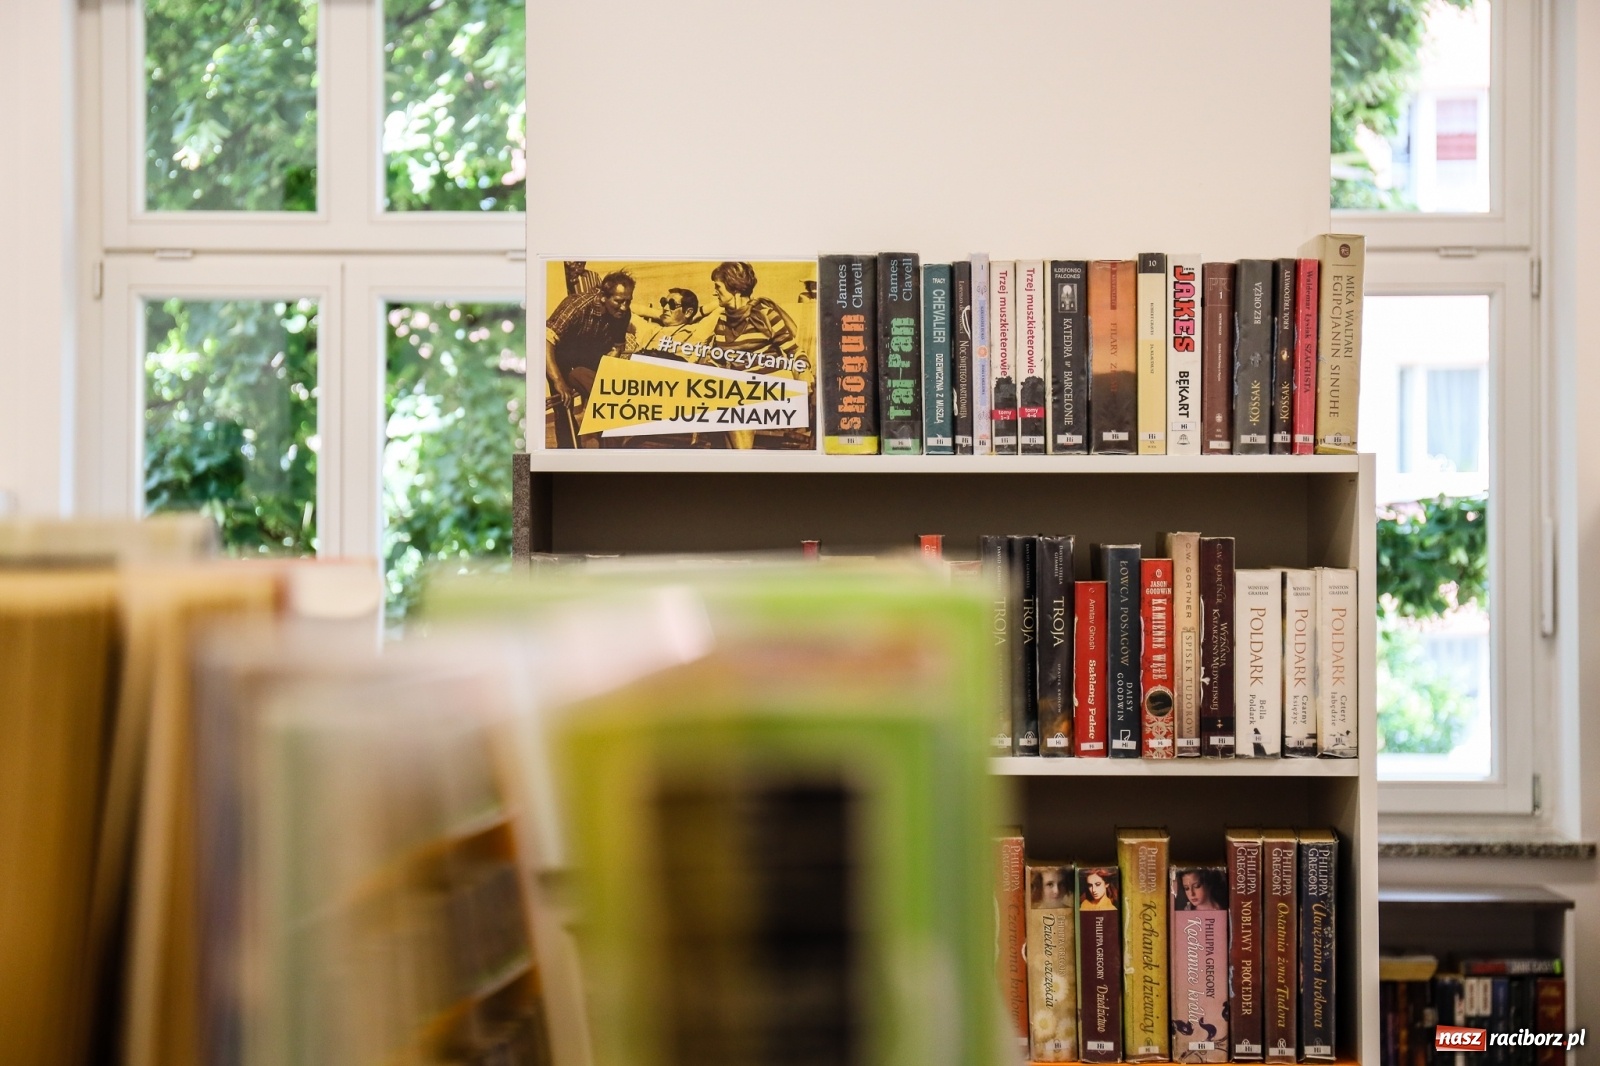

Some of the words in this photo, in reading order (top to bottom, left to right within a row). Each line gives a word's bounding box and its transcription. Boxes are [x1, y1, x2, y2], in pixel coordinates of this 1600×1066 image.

[837, 264, 848, 309] James
[852, 263, 863, 308] Clavell
[888, 260, 898, 302] James
[902, 258, 913, 301] Clavell
[998, 270, 1008, 294] Trzej
[1024, 267, 1036, 291] Trzej
[1252, 281, 1263, 309] ORĘŻA
[1283, 269, 1292, 311] TRĘDOWATY
[1305, 270, 1313, 310] Waldemar
[1345, 275, 1356, 305] MIKA
[932, 289, 946, 343] CHEVALIER
[1173, 265, 1196, 352] JAKES
[1254, 310, 1262, 324] BEZ
[1283, 313, 1291, 330] KRÓL
[1331, 275, 1343, 358] EGIPCJANIN
[658, 335, 807, 373] #retroczytanie
[999, 295, 1009, 377] muszkieterowie
[1026, 294, 1036, 374] muszkieterowie
[1063, 318, 1072, 358] KATEDRA
[1344, 309, 1353, 358] WALTARI
[599, 379, 679, 398] LUBIMY
[686, 376, 791, 405] KSIĄŻKI,
[838, 314, 867, 430] shogun
[935, 353, 944, 391] DZIEWCZYNA
[1304, 343, 1312, 393] SZACHISTA
[1329, 364, 1341, 418] SINUHE
[592, 399, 663, 421] KTÓRE
[670, 402, 709, 423] JUŻ
[717, 407, 797, 426] ZNAMY
[933, 400, 944, 424] MUSZLĄ
[1063, 370, 1073, 425] BARCELONIE
[1176, 371, 1190, 418] BĘKART
[1119, 560, 1129, 603] ŁOWCA
[992, 597, 1006, 646] TROJA
[1021, 595, 1034, 645] TROJA
[1050, 596, 1065, 647] TROJA
[1119, 607, 1131, 666] POSAGÓW
[1152, 598, 1167, 649] KAMIENNE
[1211, 608, 1220, 662] KATARZYNY
[1149, 653, 1168, 680] WĘŻE
[1185, 635, 1193, 673] SPISEK
[1219, 622, 1230, 667] WYZNANIA
[1250, 607, 1266, 688] POLDARK
[1294, 609, 1308, 688] POLDARK
[1331, 608, 1346, 687] POLDARK
[1087, 660, 1096, 704] Szklany
[1185, 677, 1195, 735] TUDORÓW
[1249, 694, 1257, 725] Poldark
[1291, 695, 1299, 725] księżyc
[1300, 695, 1308, 725] Czarny
[1339, 695, 1347, 723] Cztery
[1002, 845, 1010, 892] GREGORY
[1010, 845, 1021, 892] PHILIPPA
[1138, 846, 1147, 893] GREGORY
[1147, 847, 1158, 893] PHILIPPA
[1236, 847, 1247, 895] GREGORY
[1247, 848, 1258, 895] PHILIPPA
[1272, 848, 1282, 896] GREGORY
[1282, 849, 1294, 896] PHILIPPA
[1308, 848, 1319, 897] GREGORY
[1319, 849, 1331, 896] PHILIPPA
[1007, 902, 1020, 974] Czerwona
[1042, 913, 1057, 958] Dziecko
[1057, 915, 1066, 945] PHILIPPA
[1096, 916, 1104, 947] PHILIPPA
[1141, 901, 1159, 970] Kochanek
[1205, 918, 1215, 956] PHILIPPA
[1241, 900, 1252, 952] NOBLIWY
[1277, 902, 1290, 952] Ostatnia
[1311, 900, 1328, 973] Uwięziona
[1097, 947, 1105, 980] GREGORY
[1184, 917, 1204, 985] Kochanice
[1277, 956, 1289, 983] żona
[1043, 960, 1057, 1009] szczęścia
[1205, 958, 1215, 999] GREGORY
[1241, 959, 1253, 1016] PROCEDER
[1096, 984, 1109, 1033] Dziedzictwo
[1140, 974, 1160, 1034] dziewicy
[1187, 989, 1204, 1024] króla
[1276, 985, 1289, 1028] Tudora
[1314, 977, 1328, 1028] królowa
